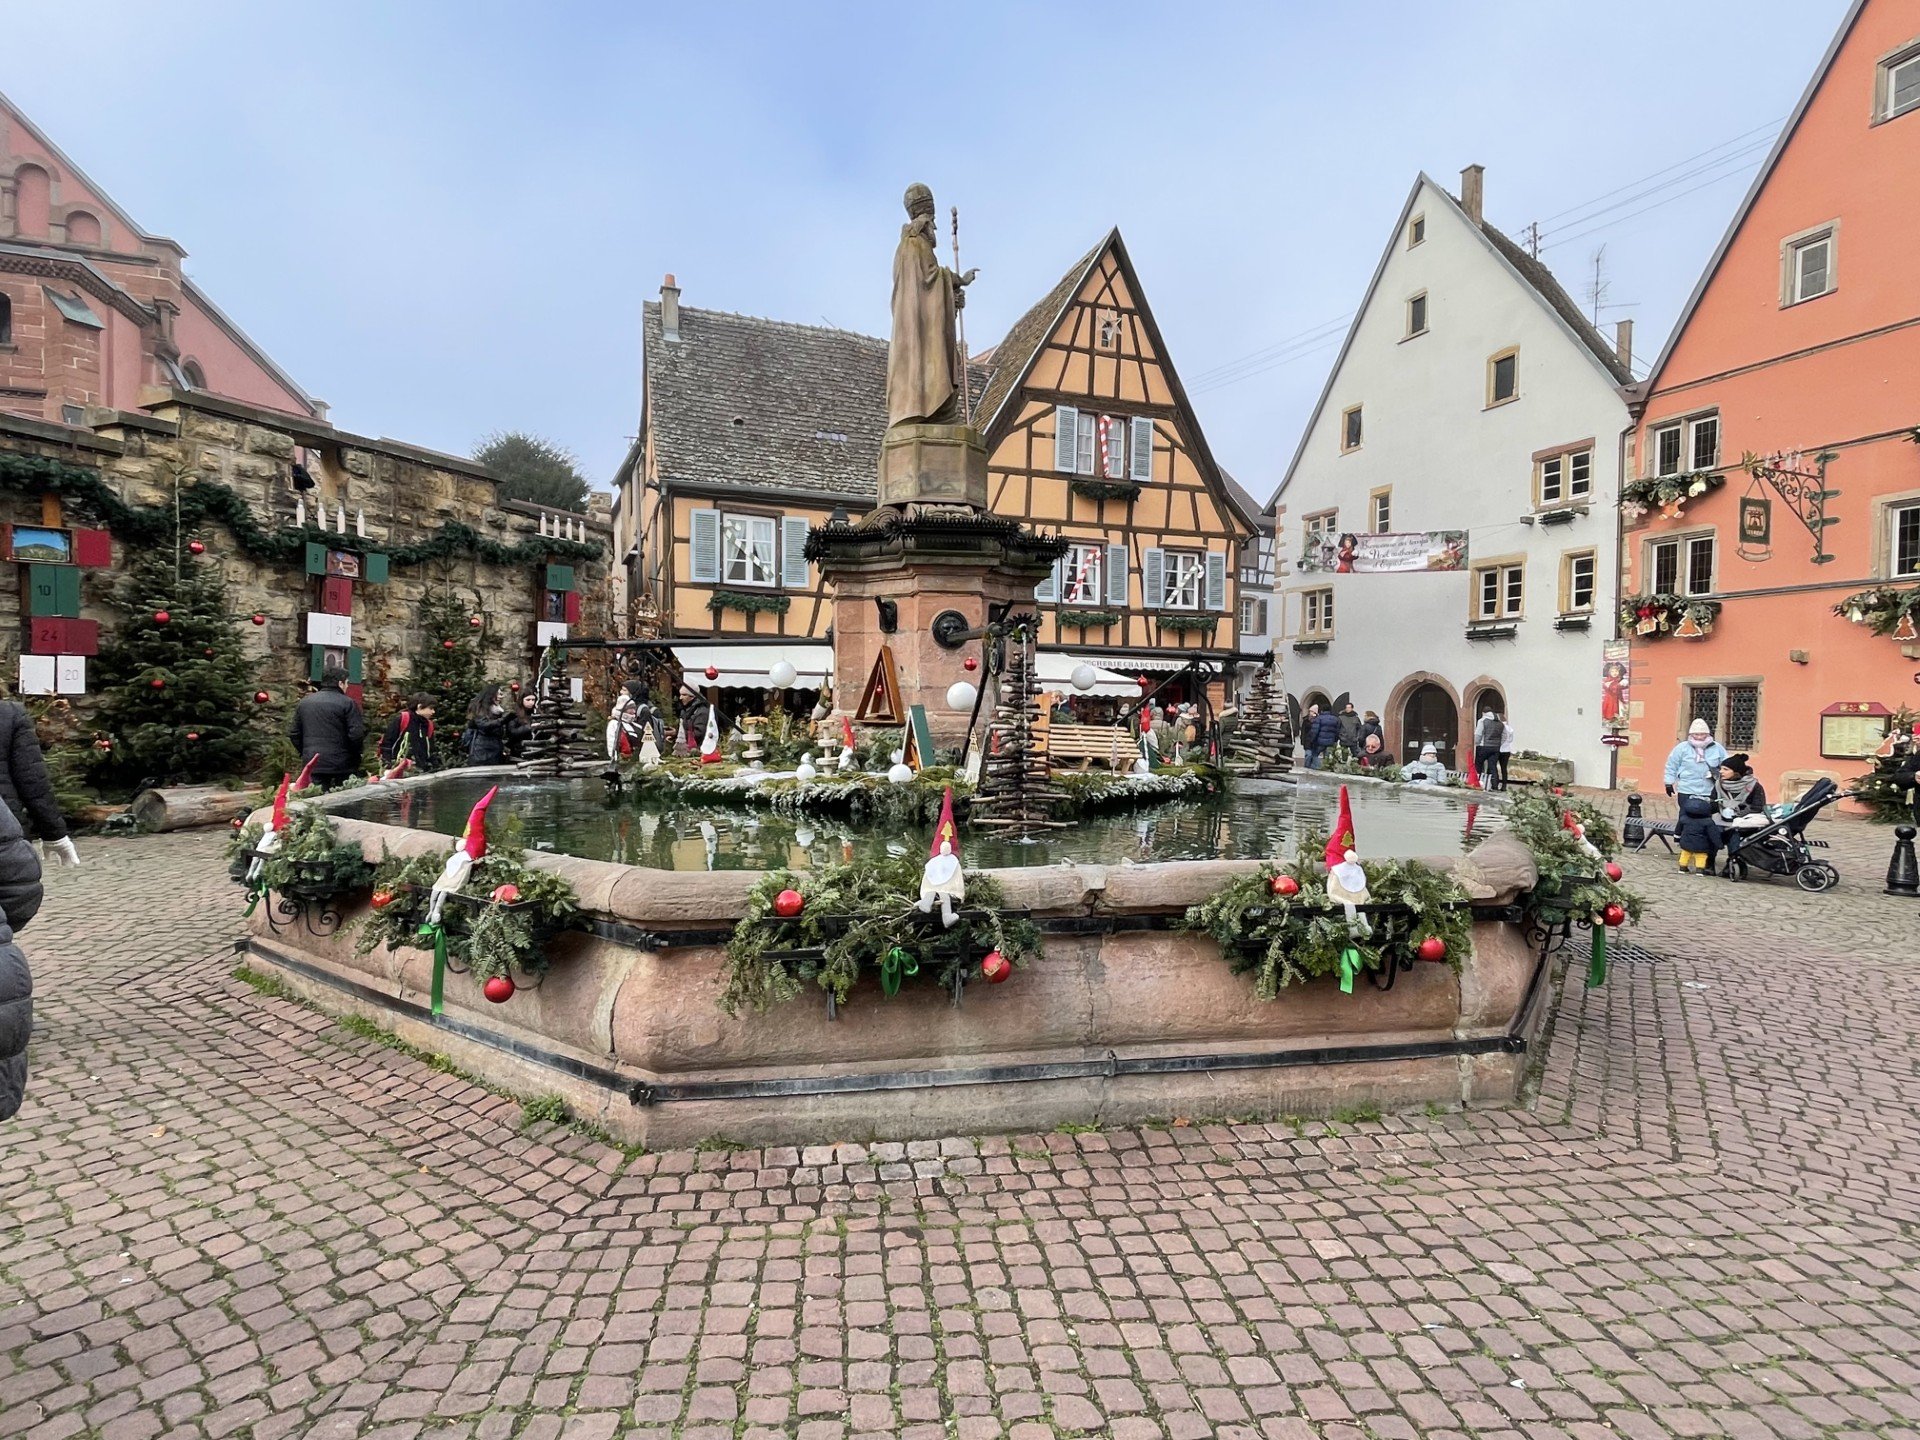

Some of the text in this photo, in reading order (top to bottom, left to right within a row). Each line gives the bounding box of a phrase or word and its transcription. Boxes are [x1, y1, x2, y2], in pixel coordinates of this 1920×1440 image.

[37, 585, 50, 596] 10
[40, 630, 58, 642] 24
[336, 625, 346, 636] 23
[64, 669, 79, 681] 20
